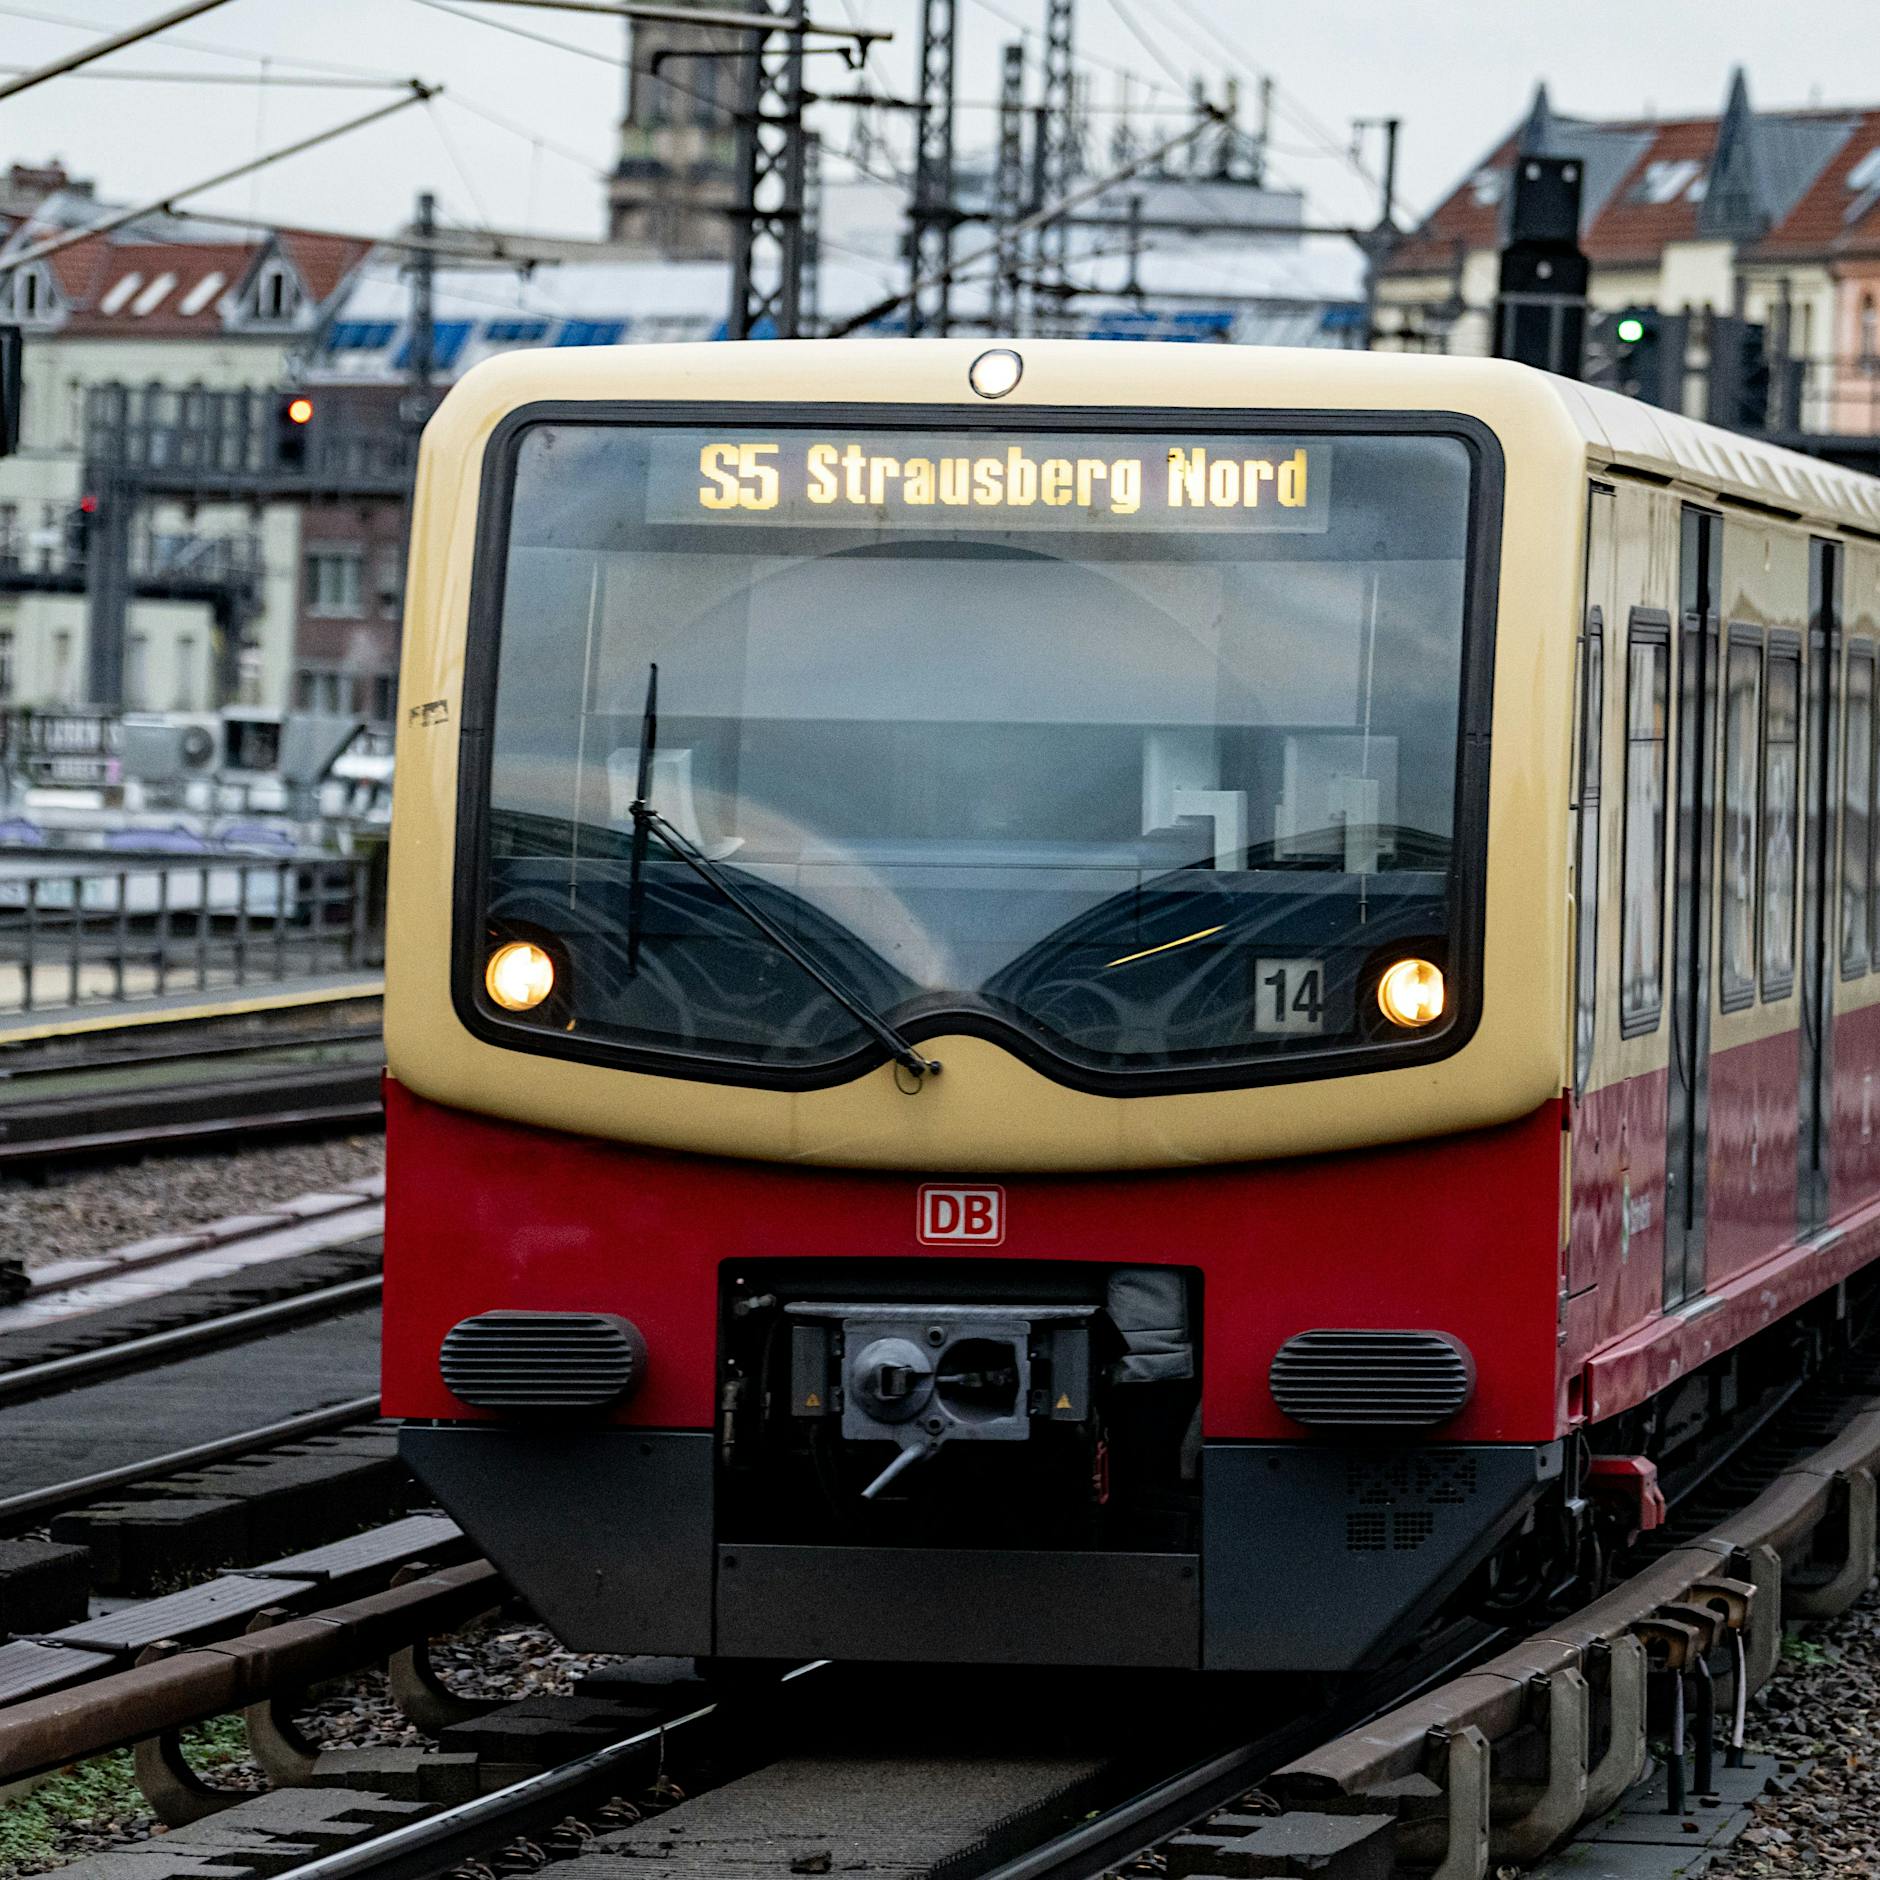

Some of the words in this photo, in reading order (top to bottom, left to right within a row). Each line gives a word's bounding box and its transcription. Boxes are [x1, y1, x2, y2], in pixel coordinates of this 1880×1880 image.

[699, 443, 779, 510] S5
[807, 444, 1142, 514] Strausberg
[1167, 447, 1307, 508] Nord
[1264, 968, 1324, 1023] 14
[930, 1194, 993, 1235] DB
